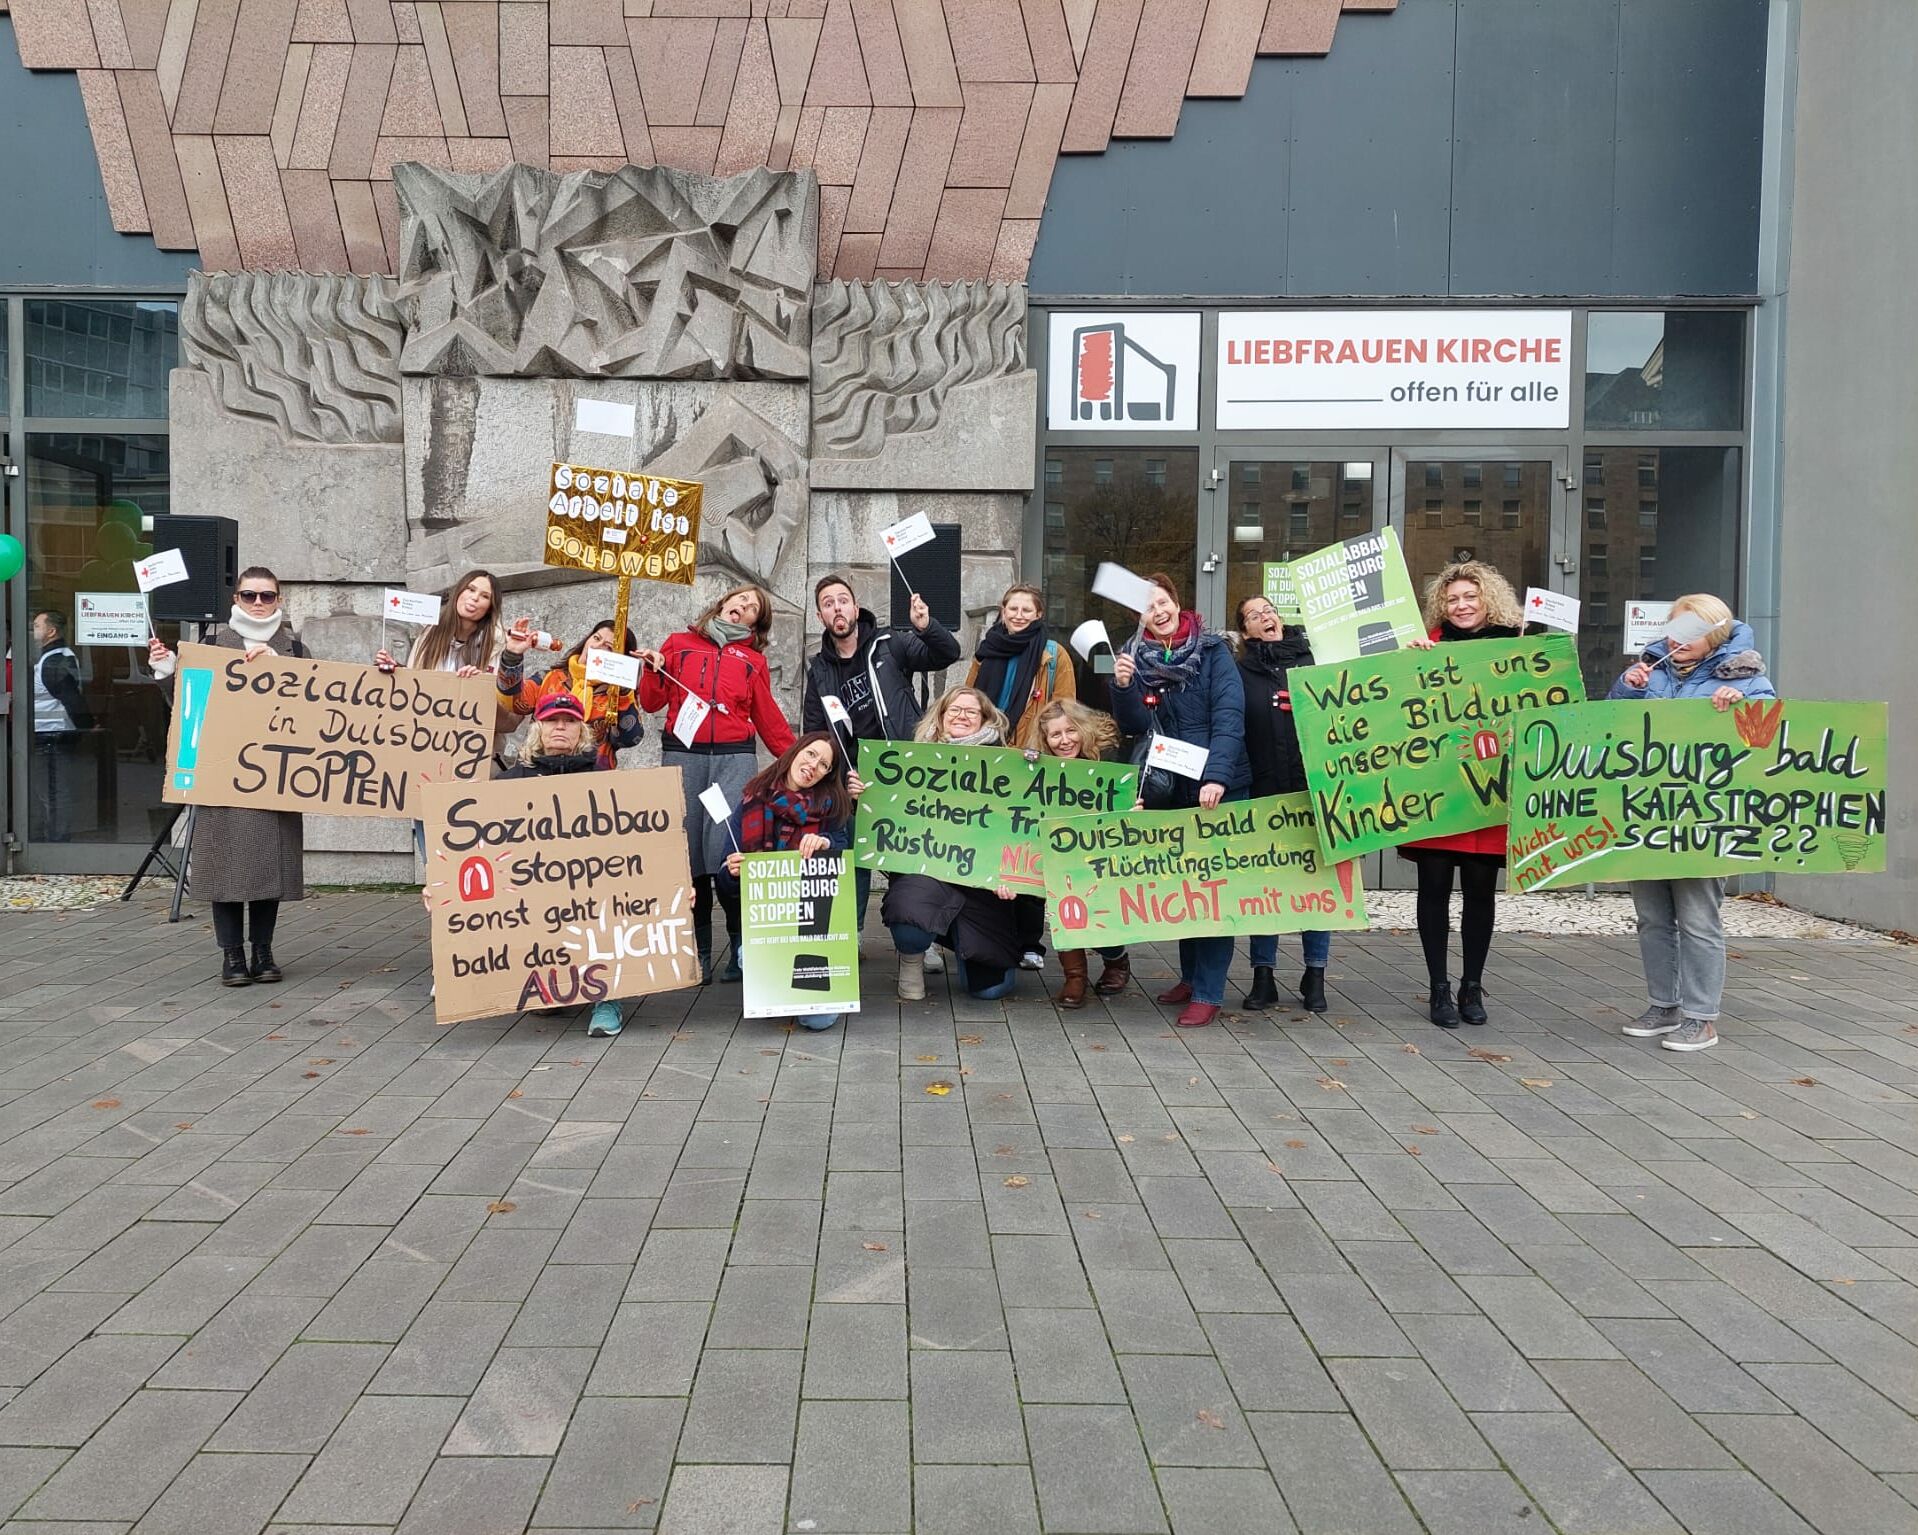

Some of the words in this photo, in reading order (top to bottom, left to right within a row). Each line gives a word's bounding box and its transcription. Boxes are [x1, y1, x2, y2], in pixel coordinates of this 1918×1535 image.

[1227, 338, 1428, 365] LIEBFRAUEN
[1436, 338, 1562, 363] KIRCHE
[1390, 380, 1458, 402] offen
[1466, 380, 1503, 402] für
[1510, 380, 1559, 402] alle
[560, 469, 677, 503] Soziale
[553, 493, 636, 523] Arbeit
[654, 510, 687, 534] ist
[1296, 535, 1389, 580] SOZIALABBAU
[1302, 583, 1316, 597] IN
[1318, 555, 1386, 590] DUISBURG
[1268, 580, 1276, 591] IN
[1279, 580, 1294, 591] DUI
[1306, 580, 1367, 614] STOPPEN
[226, 658, 481, 725] Sozialabbau
[1305, 670, 1389, 711] Was
[1416, 656, 1463, 689] ist
[1495, 651, 1551, 674] uns
[268, 706, 296, 735] in
[319, 709, 492, 779] Duisburg
[1327, 715, 1369, 746] die
[1524, 712, 1752, 789] Duisburg
[1765, 720, 1868, 777] bald
[1325, 732, 1449, 778] unserer
[233, 742, 408, 812] STOPPEN
[874, 751, 1011, 798] Soziale
[1024, 766, 1120, 812] Arbeit
[905, 794, 992, 829] sichert
[1008, 806, 1044, 837] Fri
[1319, 777, 1444, 849] Kinder
[1462, 754, 1508, 807] W
[1526, 787, 1598, 819] OHNE
[1622, 784, 1886, 836] KATASTROPHEN
[872, 817, 976, 876] Rüstung
[1000, 842, 1043, 875] Nic
[1049, 817, 1185, 857] Duisburg
[1194, 810, 1254, 840] bald
[1268, 799, 1315, 831] ohn
[1511, 822, 1565, 862] Nicht
[510, 852, 643, 890] stoppen
[747, 858, 846, 880] SOZIALABBAU
[1093, 847, 1316, 883] Flüchtlingsberatung
[1516, 854, 1558, 892] mit
[1564, 816, 1619, 860] uns!
[748, 881, 764, 900] IN
[767, 879, 840, 900] DUISBURG
[1239, 885, 1283, 916] mit
[447, 899, 531, 935] sonst
[543, 897, 600, 934] geht
[612, 893, 658, 919] hier
[749, 901, 815, 923] STOPPEN
[452, 946, 510, 978] bald
[523, 942, 571, 969] das
[586, 917, 690, 961] LICHT
[516, 963, 610, 1011] AUS
